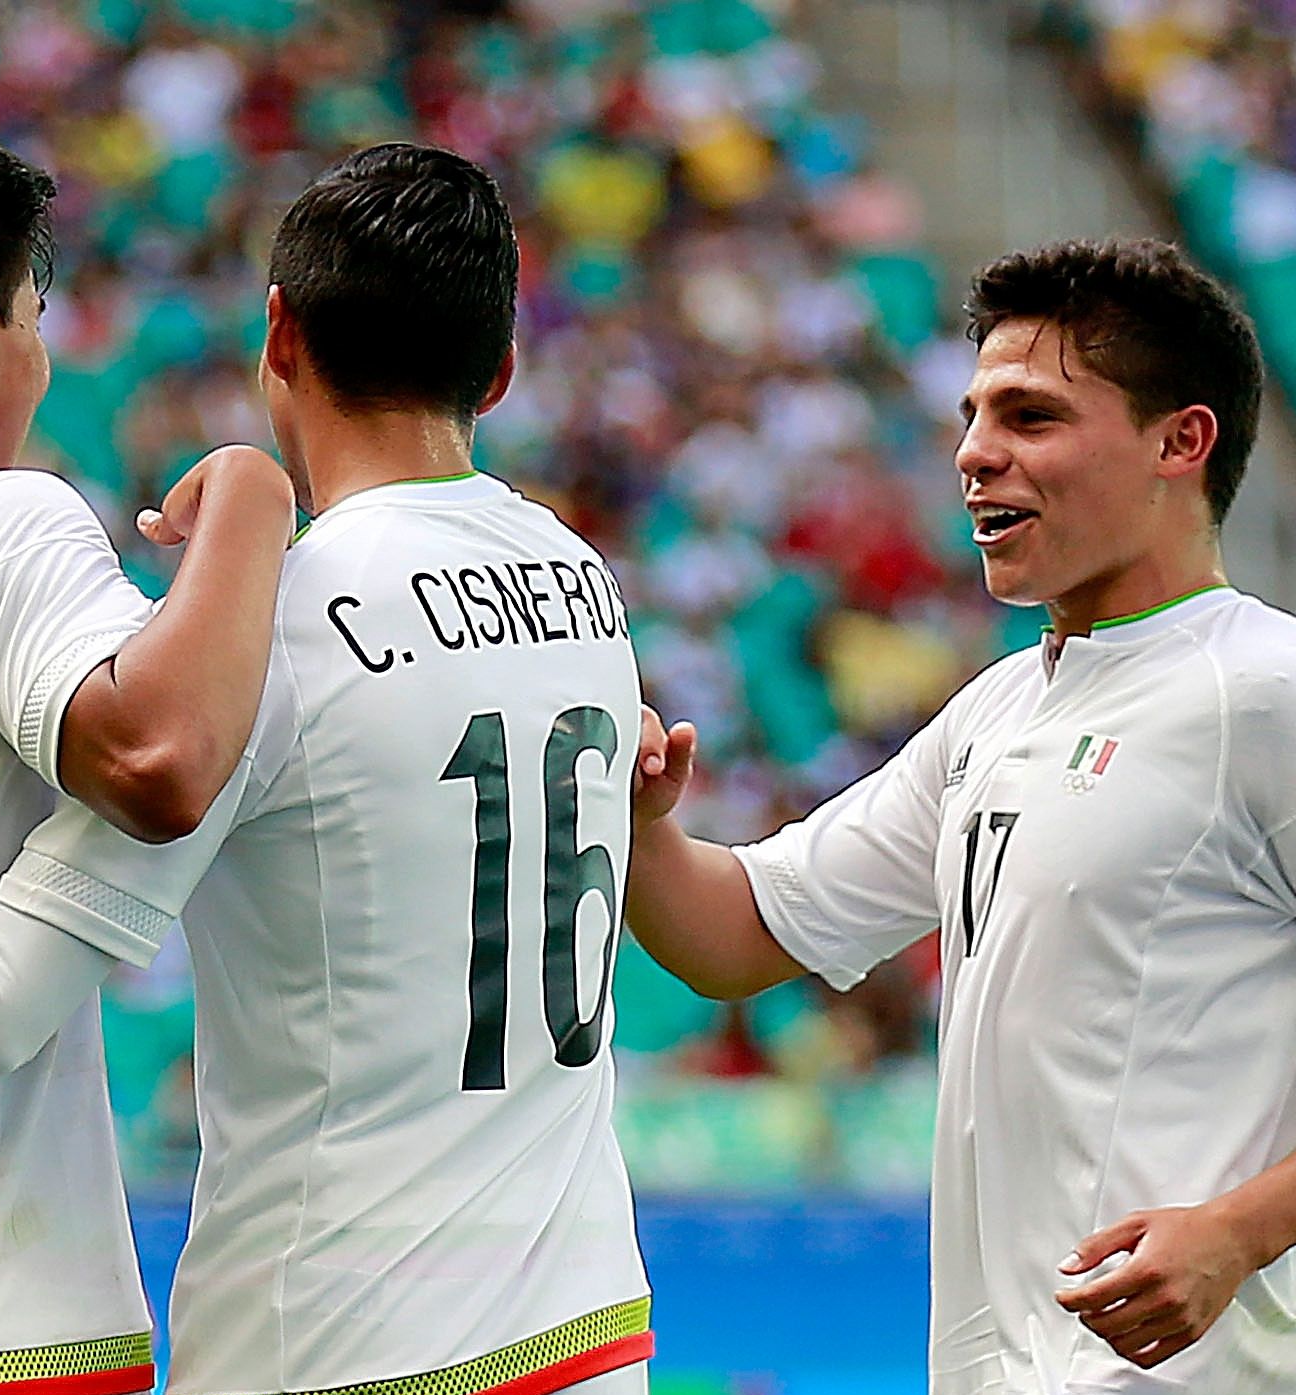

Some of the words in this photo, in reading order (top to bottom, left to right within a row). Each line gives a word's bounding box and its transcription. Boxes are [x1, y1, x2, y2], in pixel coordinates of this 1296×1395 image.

[326, 595, 416, 674] C.
[439, 705, 618, 1092] 16
[961, 810, 1022, 958] 17
